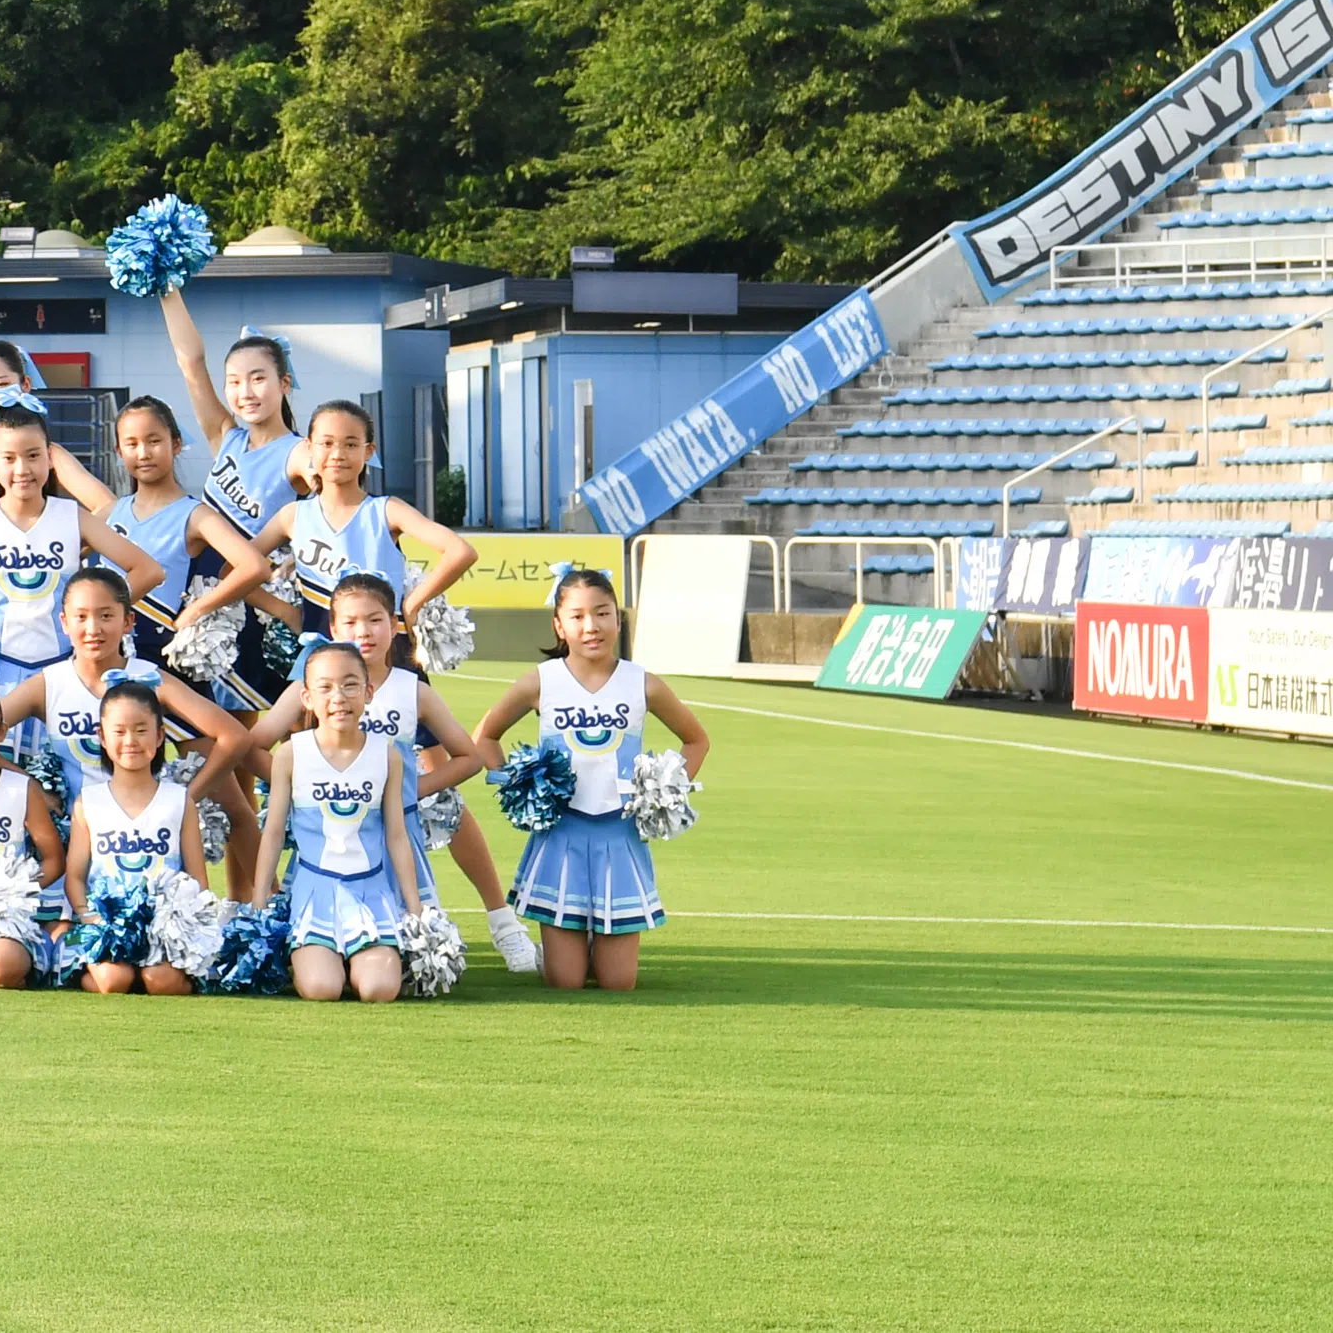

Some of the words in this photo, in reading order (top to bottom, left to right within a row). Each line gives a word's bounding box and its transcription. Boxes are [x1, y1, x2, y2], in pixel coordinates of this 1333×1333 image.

[970, 55, 1243, 279] DESTINY
[584, 466, 646, 534] NO
[762, 344, 819, 414] NO
[814, 295, 882, 377] LIFE
[846, 614, 955, 689] 明治安田
[1088, 619, 1194, 701] NOMURA
